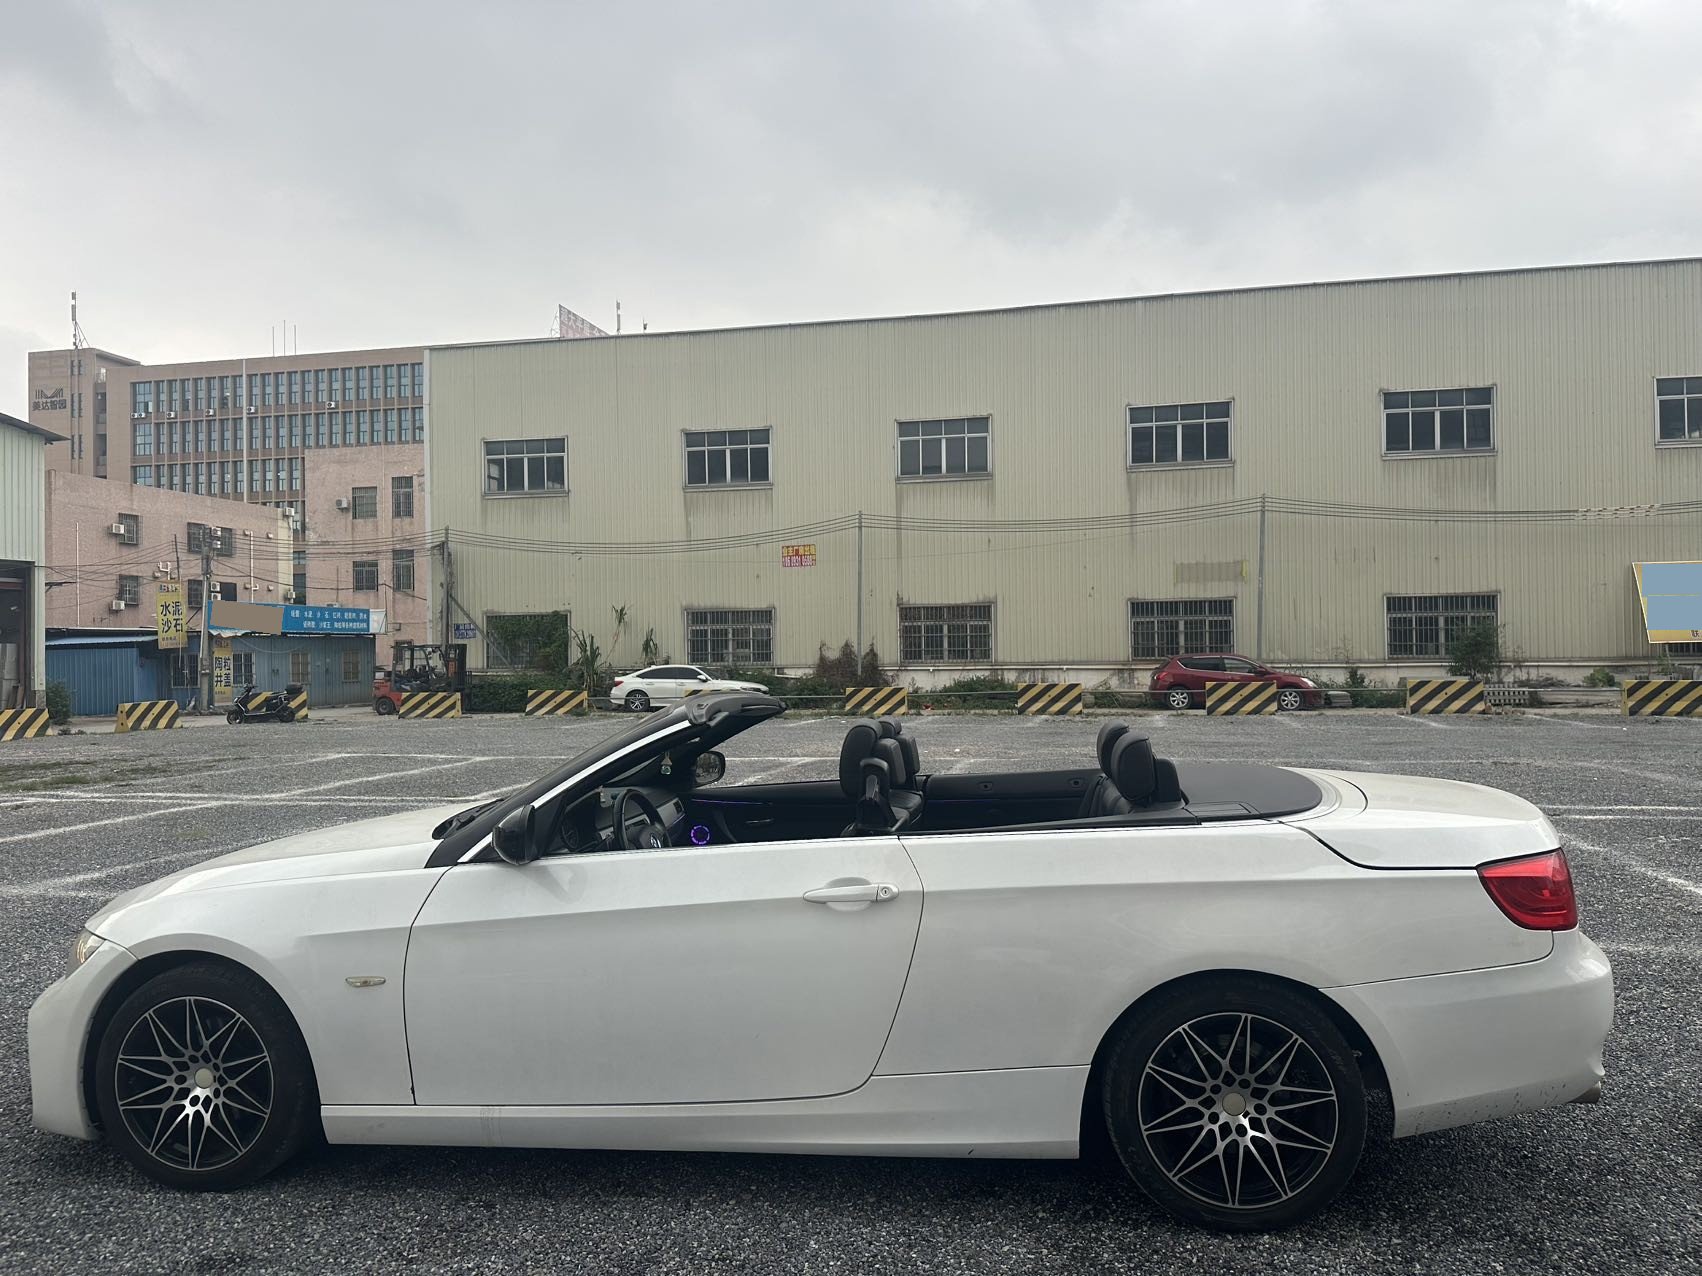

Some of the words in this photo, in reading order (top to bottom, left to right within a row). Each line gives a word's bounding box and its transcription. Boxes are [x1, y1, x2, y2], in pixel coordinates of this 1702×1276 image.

[160, 601, 182, 616] 水泥
[161, 618, 183, 633] 沙石
[215, 656, 230, 671] 陶粒
[215, 672, 231, 687] 井盖
